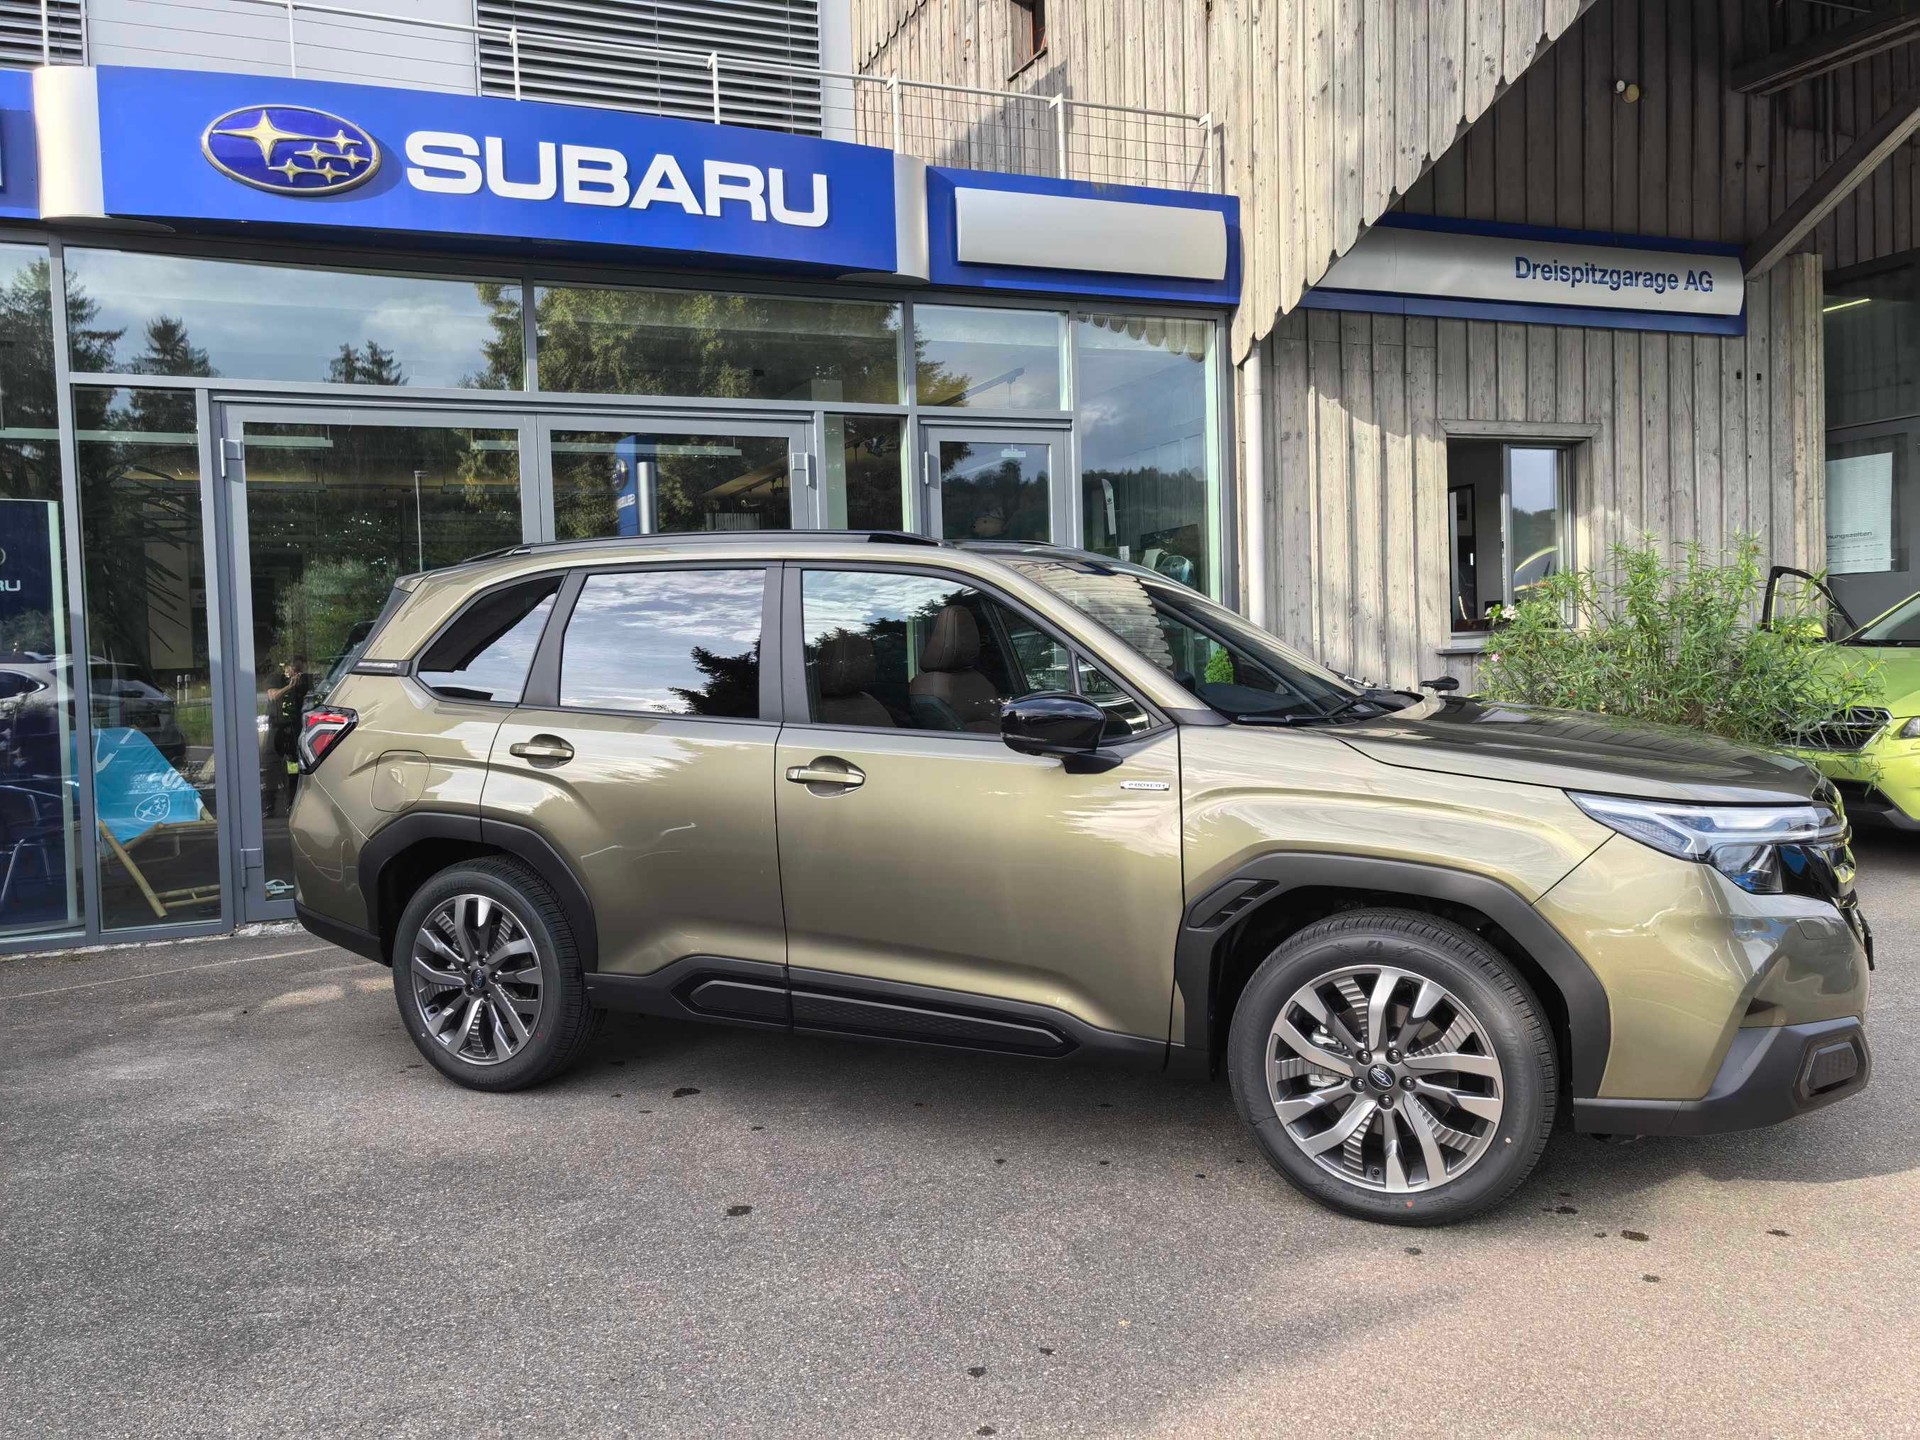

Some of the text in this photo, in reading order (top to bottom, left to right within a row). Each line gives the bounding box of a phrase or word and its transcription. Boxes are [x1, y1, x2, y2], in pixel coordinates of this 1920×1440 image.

[405, 130, 829, 228] SUBARU
[1515, 256, 1714, 294] Dreispitzgarage AG
